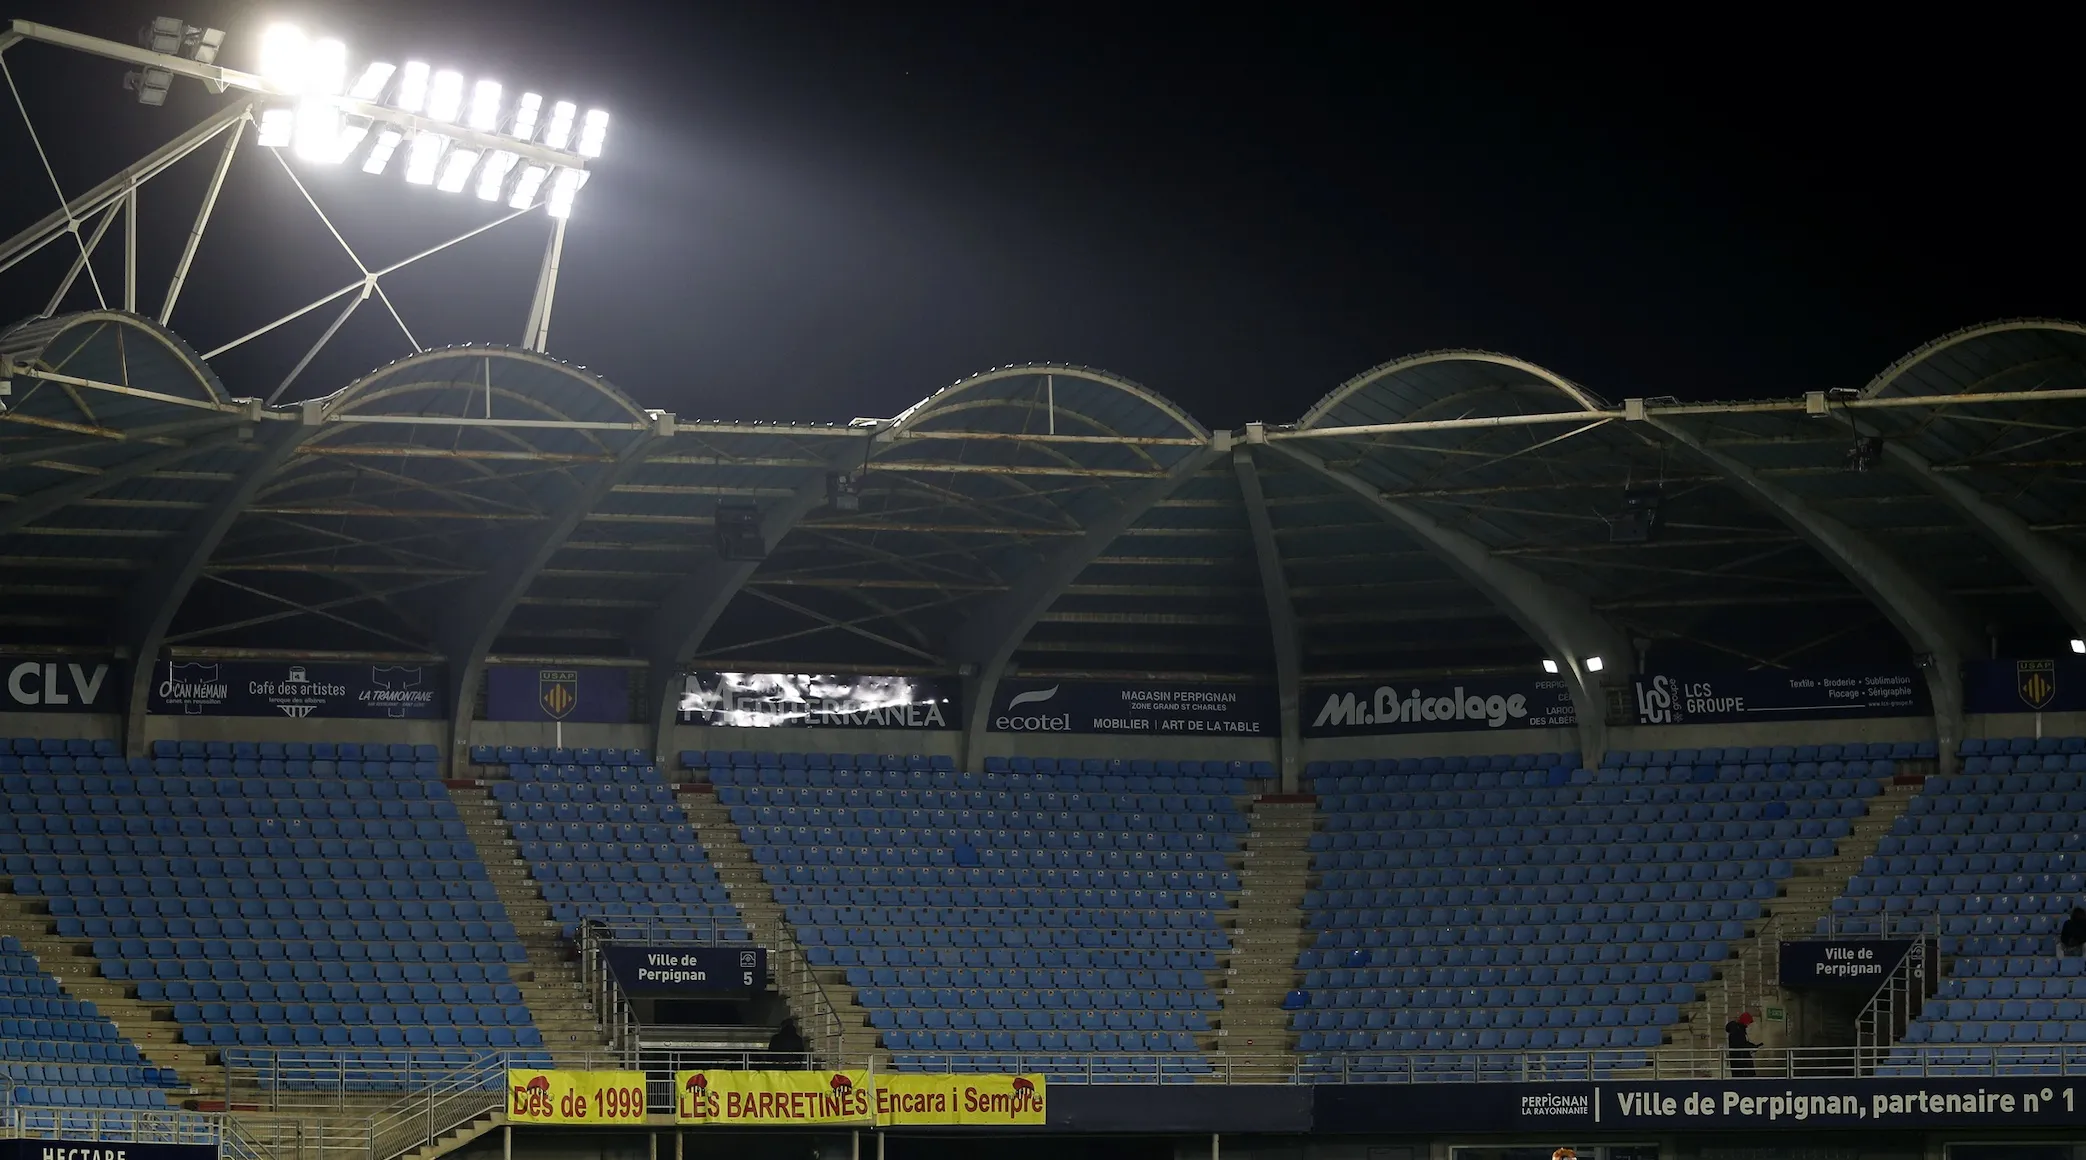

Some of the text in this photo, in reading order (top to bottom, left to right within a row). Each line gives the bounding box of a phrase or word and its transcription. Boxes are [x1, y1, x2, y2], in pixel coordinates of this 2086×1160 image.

[8, 662, 109, 705] CLV
[249, 681, 346, 696] Café des artistes
[1790, 676, 1911, 688] Textile Broderie Sublimation
[358, 690, 434, 702] LA TRAMONTANE
[1121, 690, 1236, 702] MAGASIN PERPIGNAN
[1684, 683, 1712, 698] LCS
[1828, 687, 1912, 699] Flocage Sérigraphie
[1131, 702, 1227, 711] ZONE GRAND ST CHARLES
[1687, 697, 1745, 713] GROUPE
[995, 713, 1072, 731] ecotel
[1093, 718, 1260, 732] MOBILIER ART DE LA TABLE
[1529, 717, 1547, 726] DES
[647, 953, 697, 966] Ville de
[1825, 947, 1874, 960] Ville de
[638, 968, 706, 983] Perpignan
[1815, 962, 1882, 977] Perpignan
[743, 971, 753, 986] 5
[561, 1088, 587, 1118] de
[595, 1088, 643, 1118] 1999
[680, 1087, 868, 1119] LES BARRETINES
[876, 1087, 1043, 1118] Encara i Sempre
[1617, 1087, 2074, 1120] Ville de Perpignan, partenaire n° 1
[1522, 1107, 1588, 1115] LA RAYONNANTE
